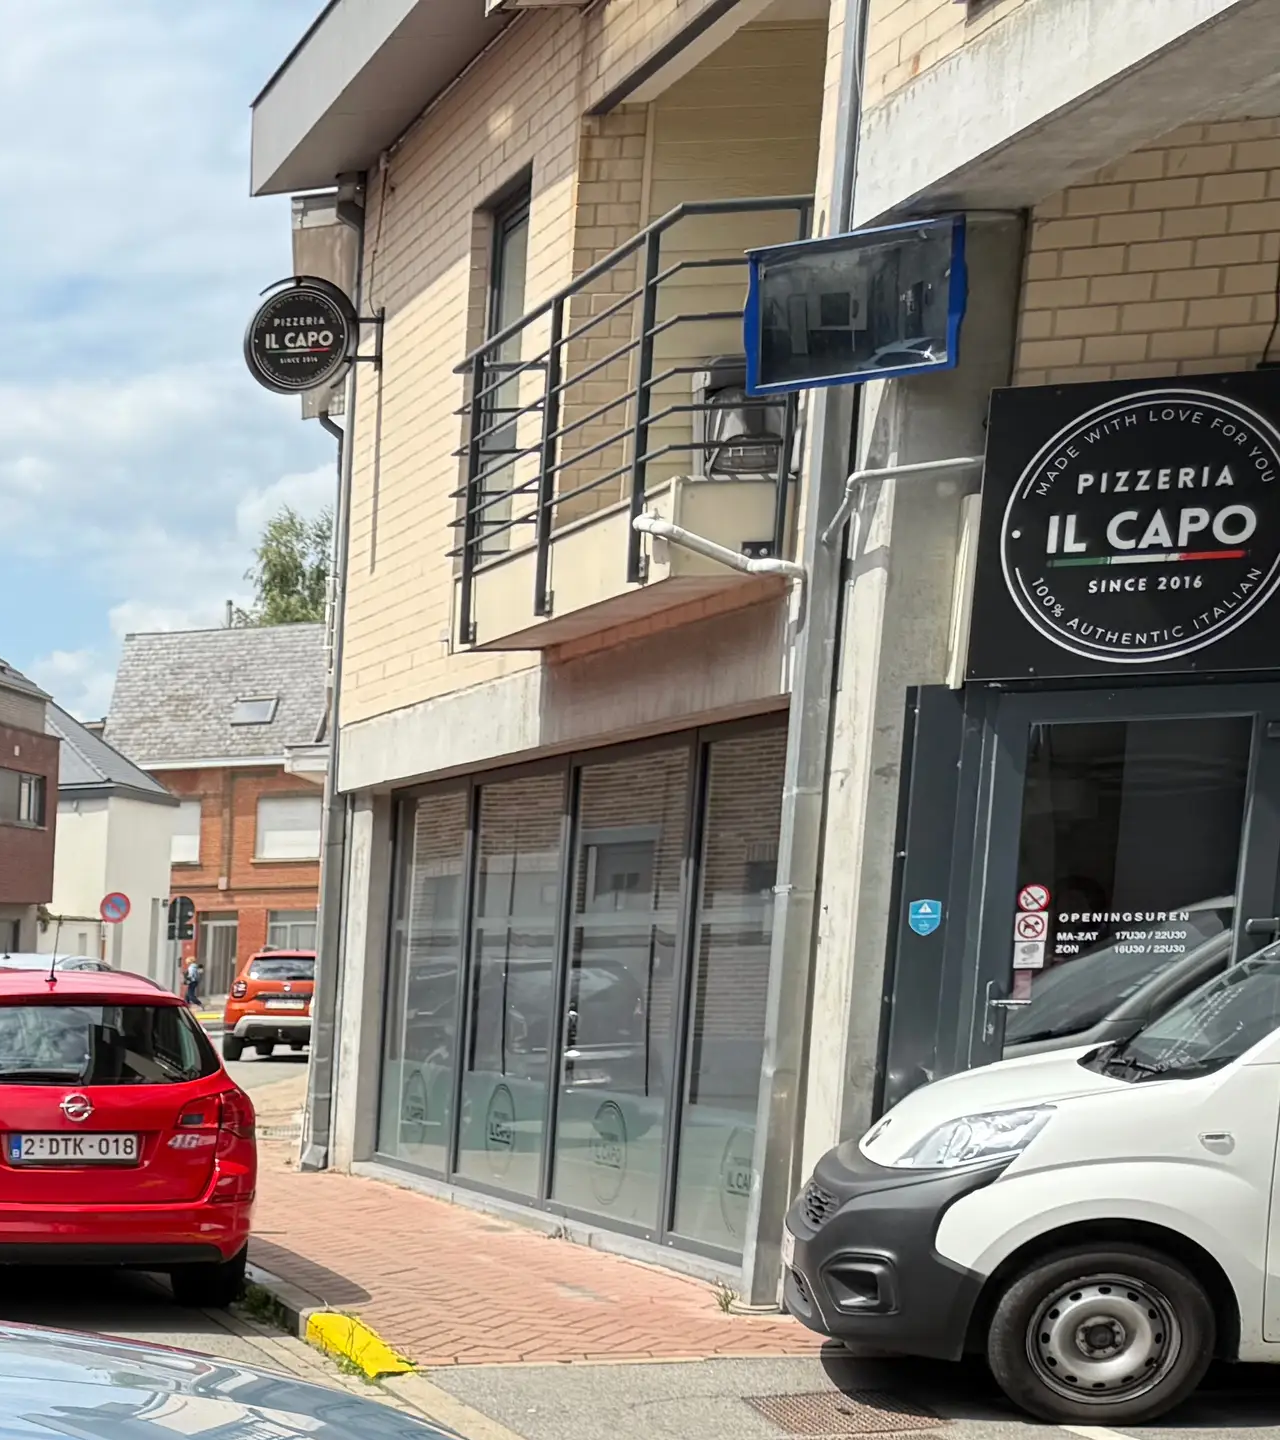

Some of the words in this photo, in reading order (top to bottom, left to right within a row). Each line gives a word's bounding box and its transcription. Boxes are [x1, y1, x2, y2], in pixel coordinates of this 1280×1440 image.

[273, 316, 325, 327] PIZZERIA
[265, 333, 280, 349] IL
[284, 330, 334, 348] CAPO
[1036, 446, 1080, 496] MADE
[1083, 414, 1137, 444] WITH
[1149, 408, 1204, 424] LOVE
[1210, 418, 1248, 446] FOR
[1248, 446, 1276, 482] YOU
[1077, 465, 1235, 495] PIZZERIA
[1046, 514, 1086, 554] IL
[1106, 504, 1257, 550] CAPO
[1088, 577, 1147, 594] SINCE
[1158, 575, 1203, 590] 2016
[1032, 577, 1065, 618] 100%
[1066, 617, 1184, 645] AUTHENTIC
[1192, 568, 1262, 629] ITALIAN
[1058, 911, 1190, 923] OPENINGSUREN
[1056, 931, 1099, 941] MA-ZAT
[1115, 931, 1146, 940] 17U30
[1154, 930, 1187, 940] 22U30
[1054, 944, 1080, 954] ZON
[1153, 944, 1186, 953] 22U30
